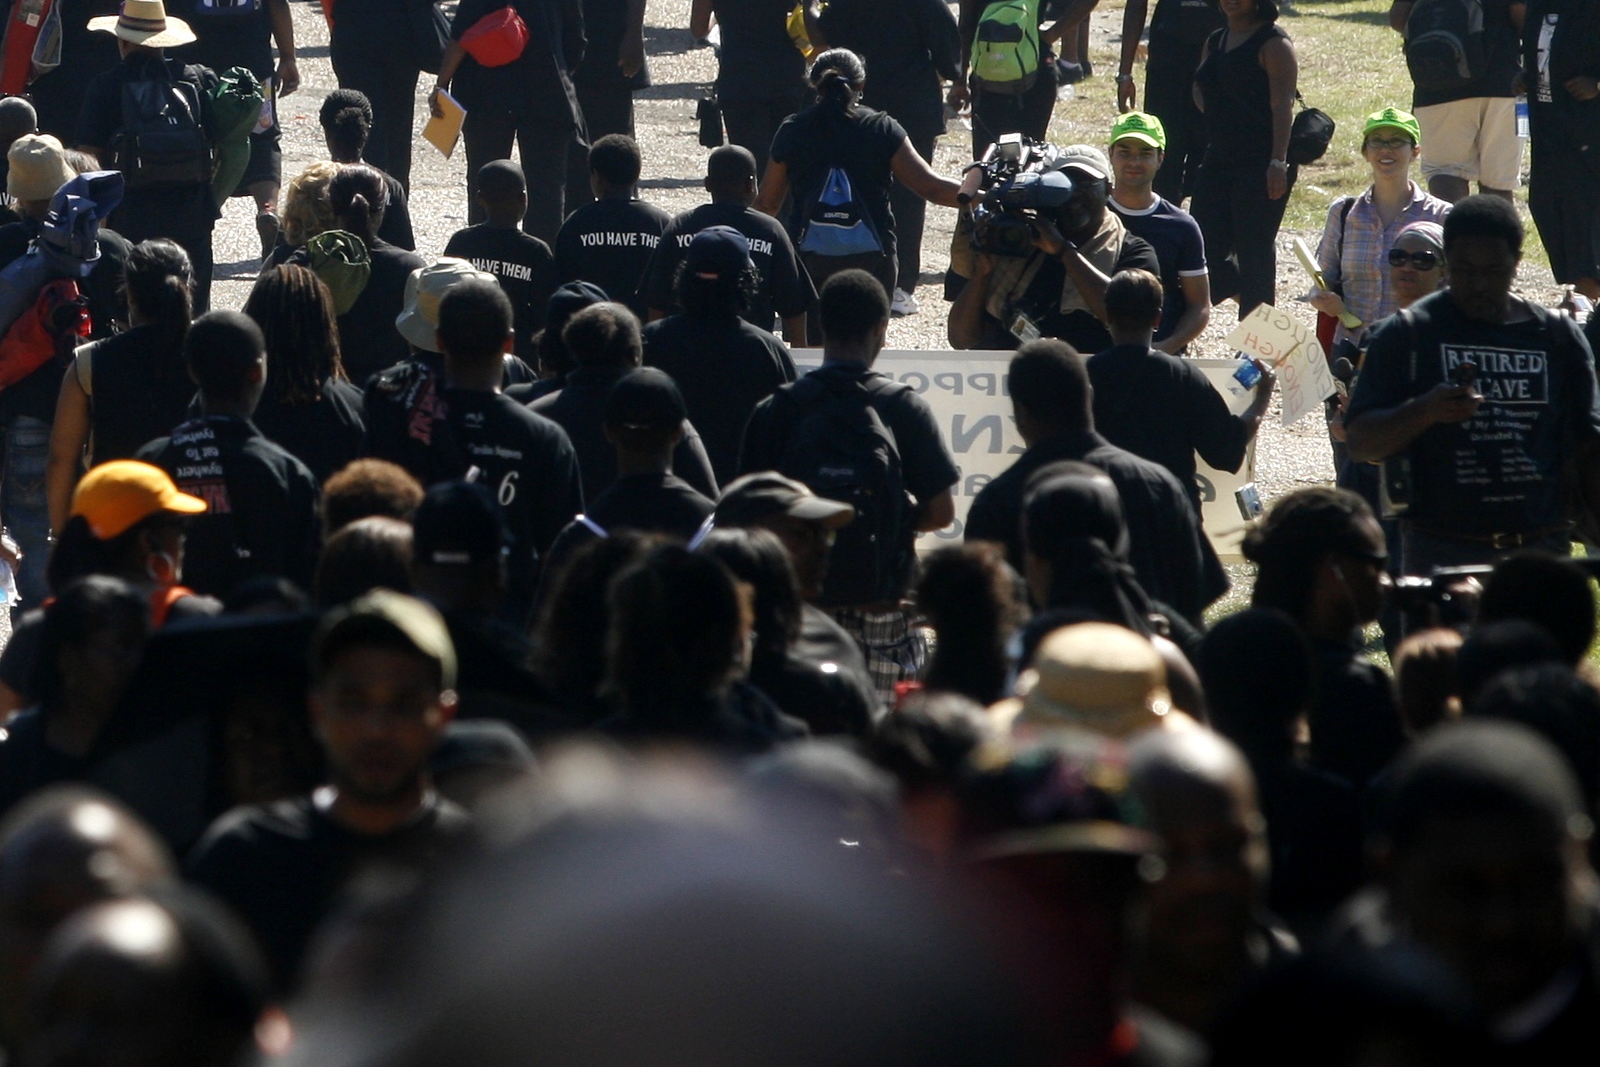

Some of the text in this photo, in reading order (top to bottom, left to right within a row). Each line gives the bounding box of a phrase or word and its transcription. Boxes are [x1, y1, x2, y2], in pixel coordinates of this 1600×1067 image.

[580, 231, 661, 250] YOU HAVE THE
[676, 234, 774, 258] YO HEM.
[472, 257, 533, 282] HAVE THEM.
[1445, 348, 1544, 374] RETIRED
[1474, 378, 1531, 400] LAVE
[497, 470, 520, 507] 6
